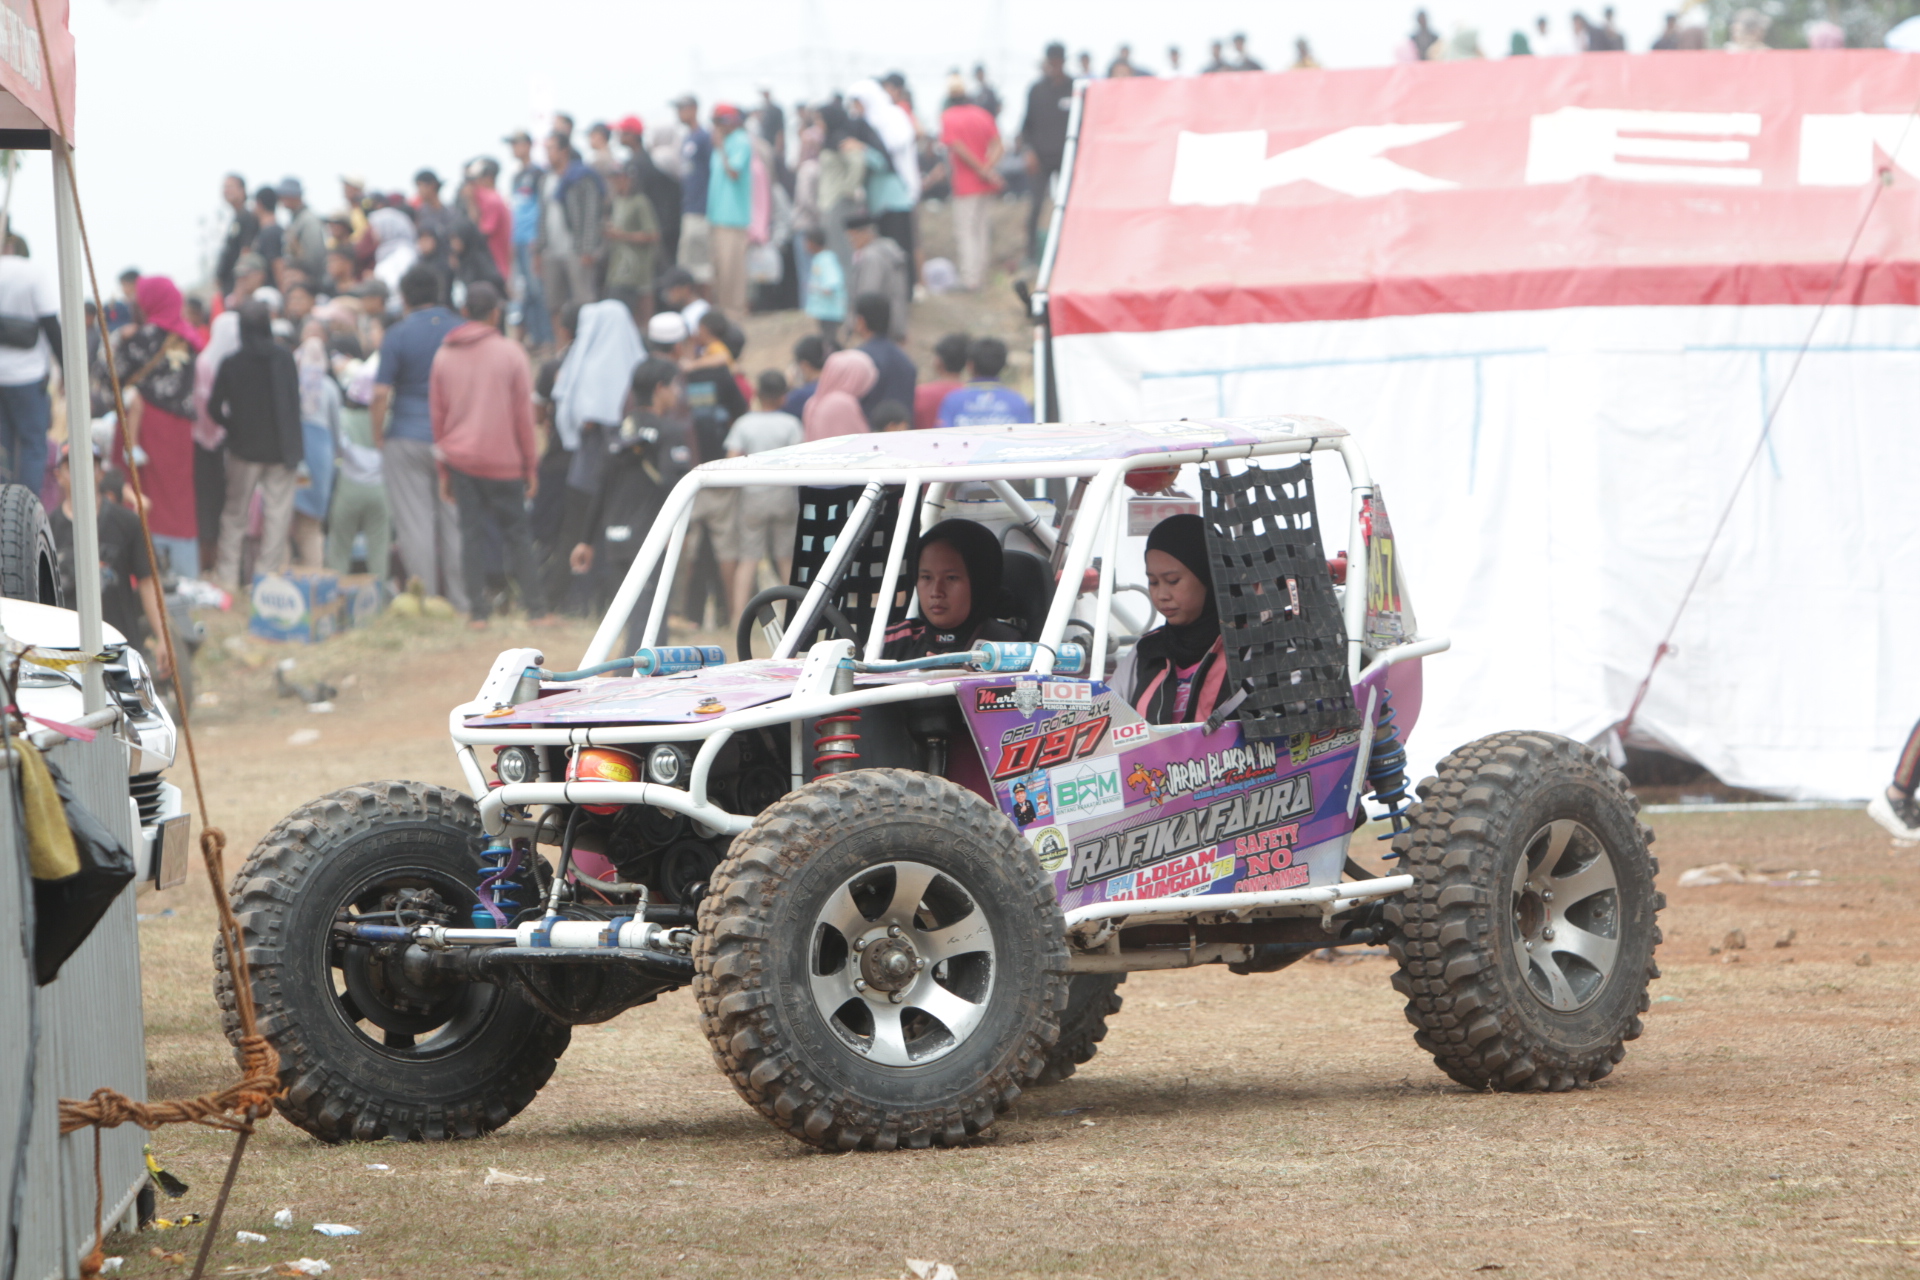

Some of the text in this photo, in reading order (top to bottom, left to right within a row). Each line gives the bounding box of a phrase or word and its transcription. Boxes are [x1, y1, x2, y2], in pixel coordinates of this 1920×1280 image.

[662, 648, 721, 662] KING
[1004, 642, 1077, 657] KIG
[1044, 684, 1090, 700] IOF
[1002, 725, 1034, 744] OFF
[1039, 713, 1076, 734] ROAD
[1113, 722, 1146, 740] IOF
[993, 715, 1111, 782] 097
[1166, 759, 1207, 797] JARAN
[1222, 766, 1275, 785] Tuban
[1068, 771, 1315, 890] RAFIKA FAHRA
[1235, 823, 1299, 857] SAFETY
[1107, 848, 1217, 896] 64 LOGAM
[1247, 848, 1292, 877] NO
[1112, 857, 1235, 901] MANUNGGAL 78
[1192, 883, 1210, 895] TEAM
[1235, 864, 1309, 893] COMPROMISE
